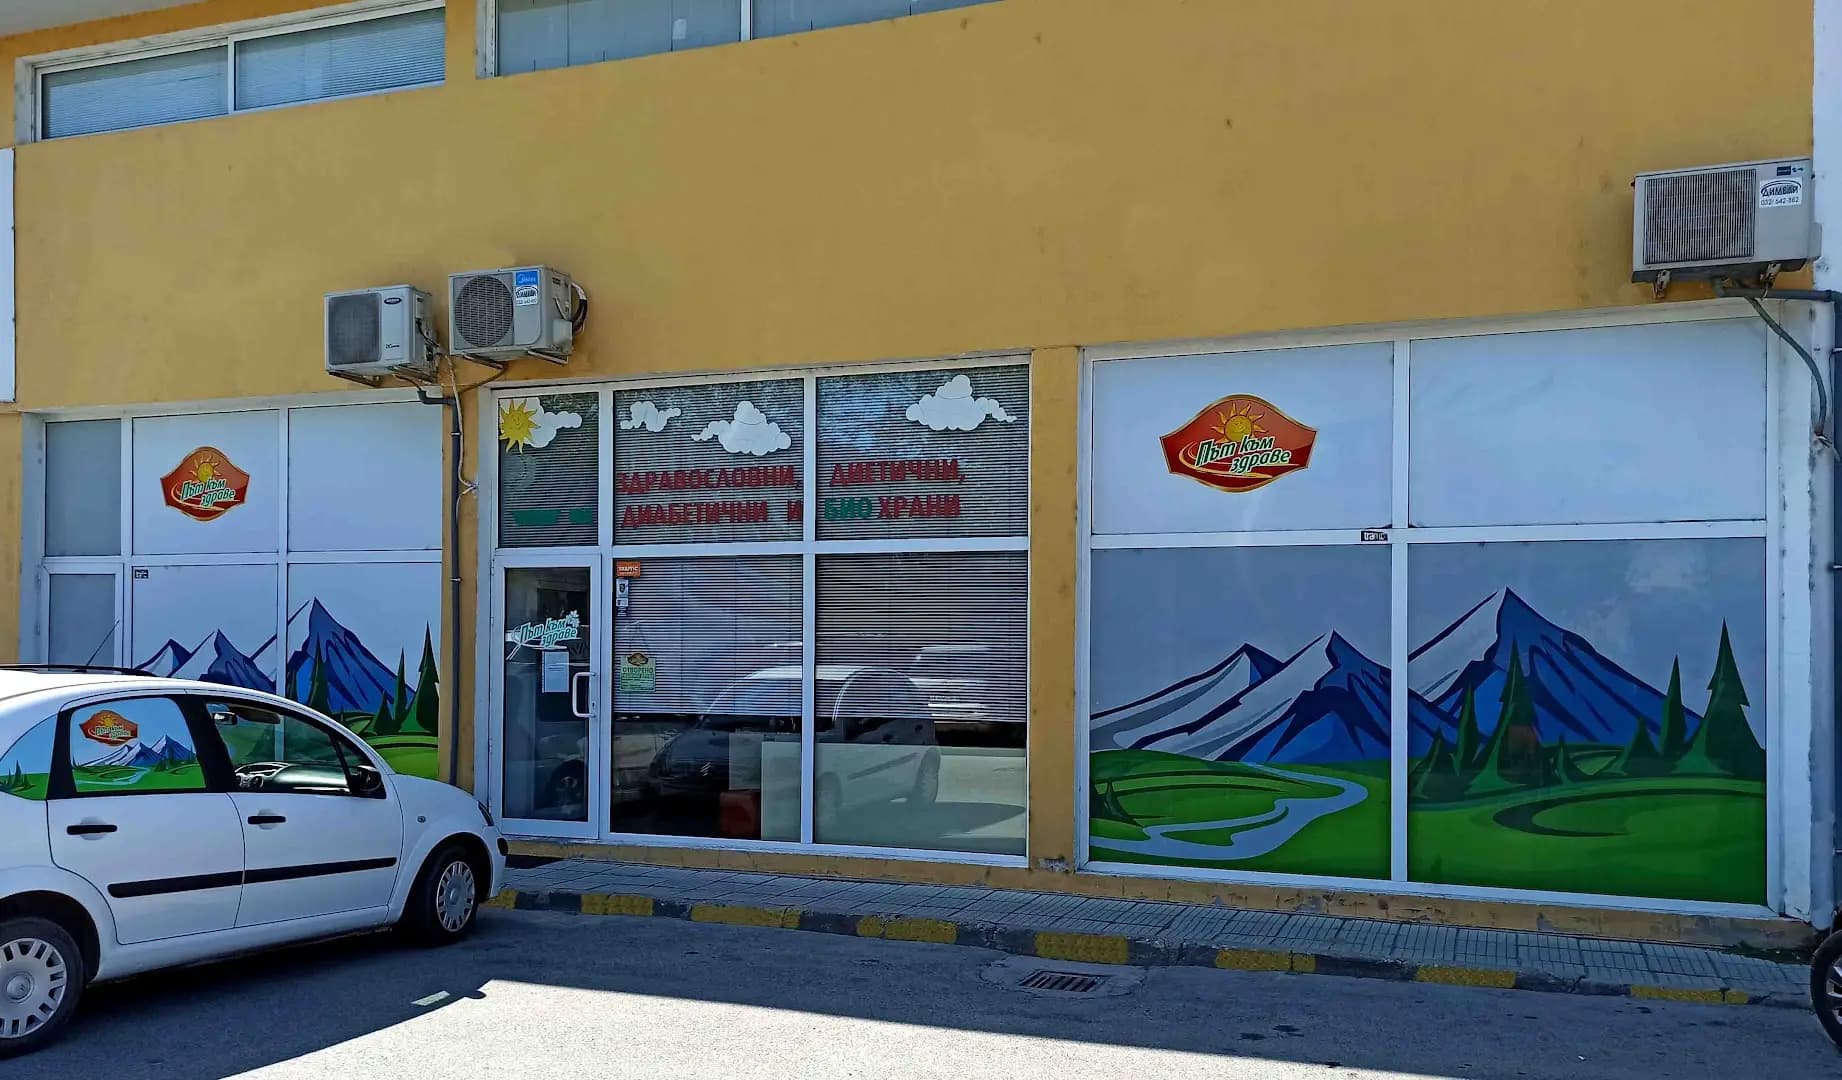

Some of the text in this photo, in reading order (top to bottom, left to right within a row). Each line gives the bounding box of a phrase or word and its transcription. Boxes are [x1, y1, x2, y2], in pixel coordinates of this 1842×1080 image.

[1195, 439, 1237, 467] Път
[1230, 448, 1291, 474] здраве
[616, 457, 967, 494] ЗДРАВОСЛОВНИ, ДИЕТИЧНИ,
[180, 480, 204, 501] Път
[621, 494, 961, 528] ДИАБЕТИЧНИ И БИО ХРАНИ
[520, 622, 544, 642] Път
